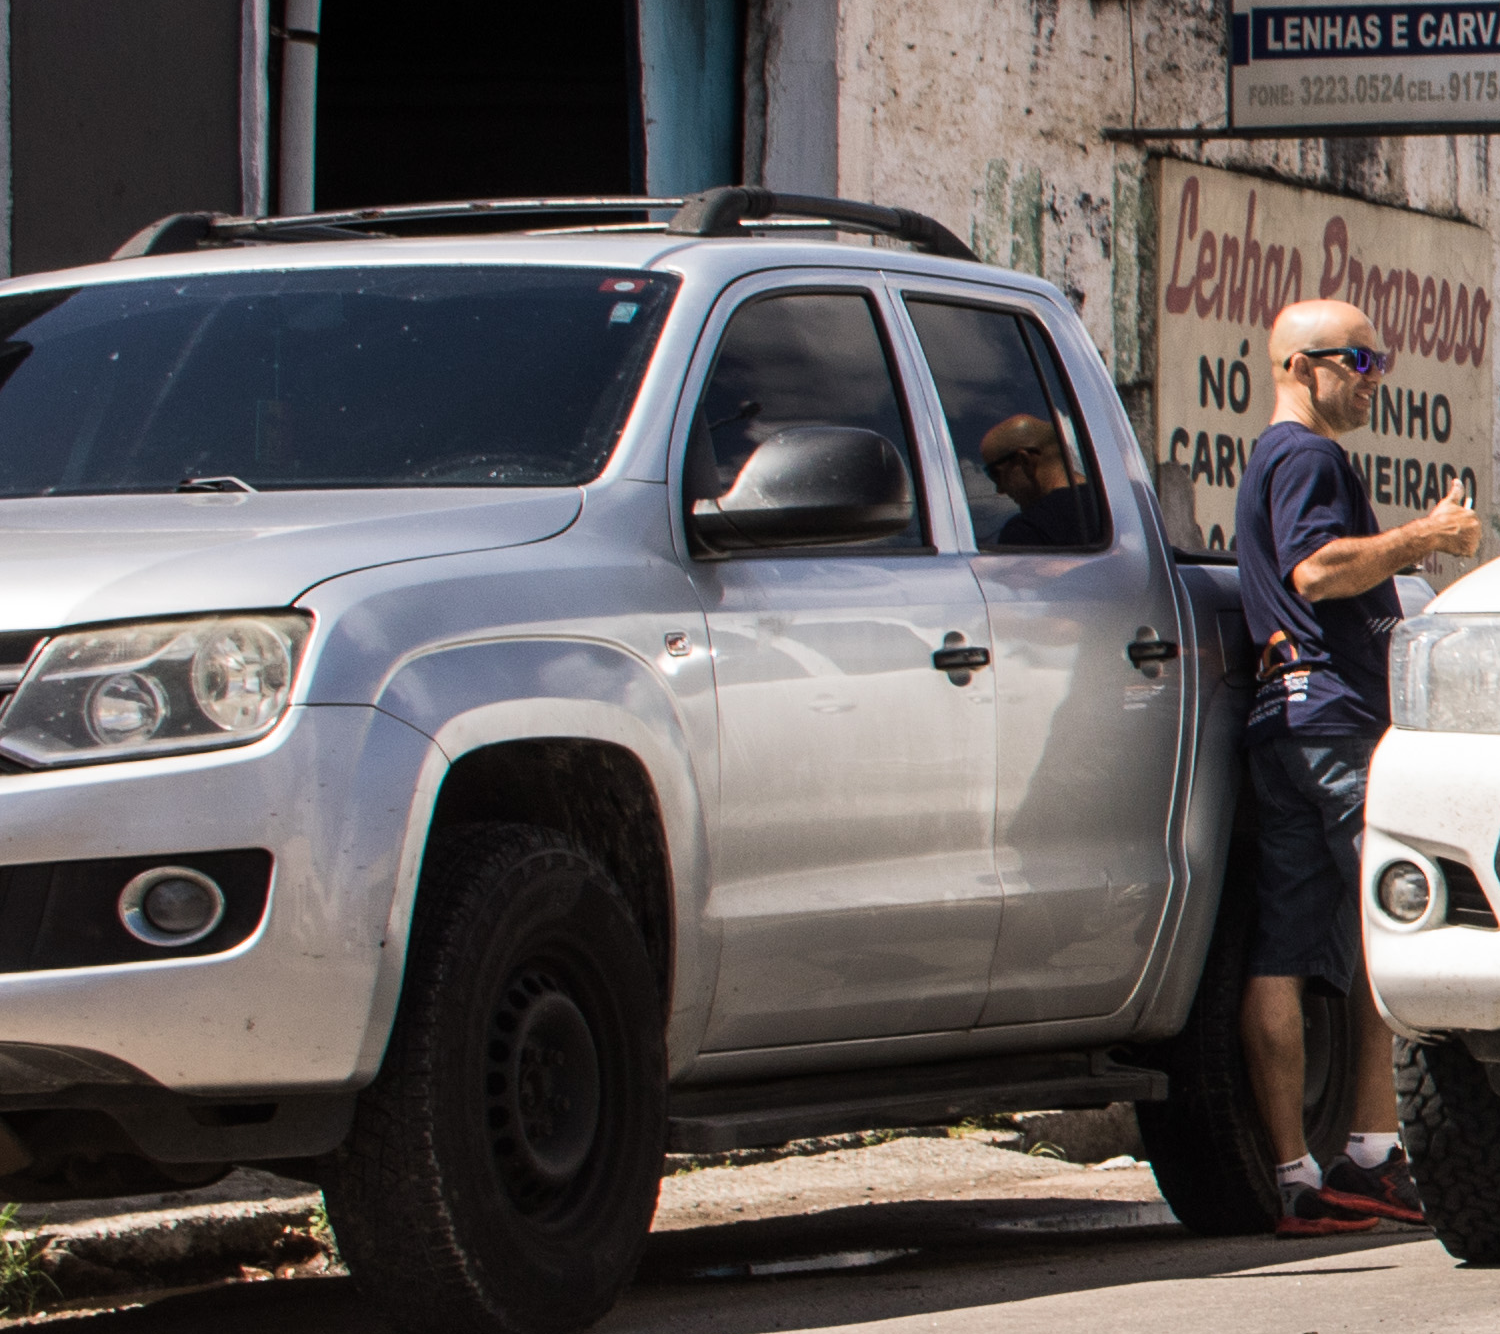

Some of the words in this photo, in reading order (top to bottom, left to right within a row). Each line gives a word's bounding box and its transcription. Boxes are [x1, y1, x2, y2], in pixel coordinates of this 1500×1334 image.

[1266, 12, 1382, 52] LENHAS
[1391, 13, 1409, 48] E
[1250, 83, 1295, 107] FONE:
[1301, 72, 1405, 106] 3223.0524
[1165, 175, 1302, 330] Lenhas
[1199, 339, 1250, 414] NÓ
[1370, 384, 1452, 443] INHO
[1170, 427, 1258, 489] CARV
[1344, 450, 1477, 511] NEIRADO
